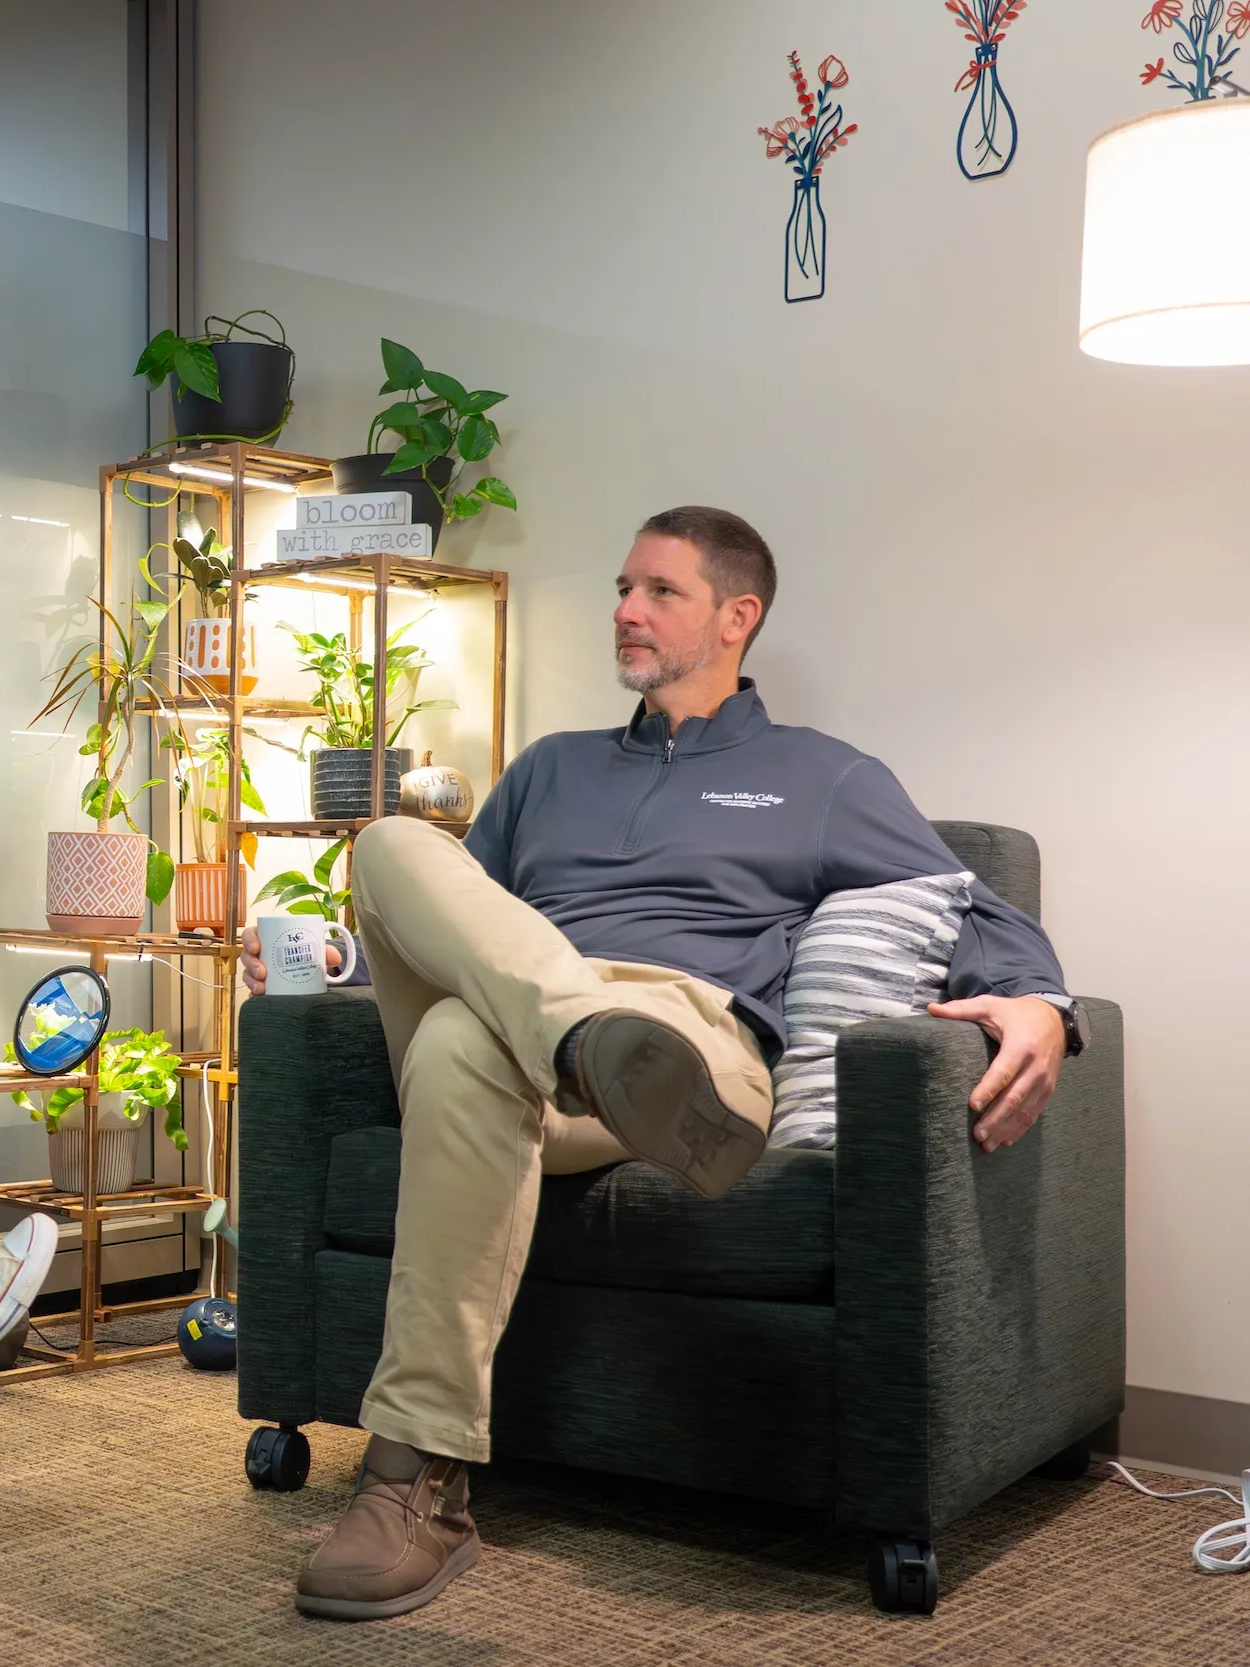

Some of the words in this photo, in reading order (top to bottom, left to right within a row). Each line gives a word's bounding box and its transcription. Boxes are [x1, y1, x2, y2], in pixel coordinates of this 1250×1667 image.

[304, 501, 398, 524] bloom
[282, 530, 338, 552] with
[351, 532, 422, 554] grace
[419, 773, 459, 789] GIVE
[700, 792, 733, 800] Lebanon
[733, 792, 756, 801] Valley
[755, 794, 784, 805] College
[284, 944, 311, 956] TRANSFER
[285, 953, 313, 965] CHAMPION
